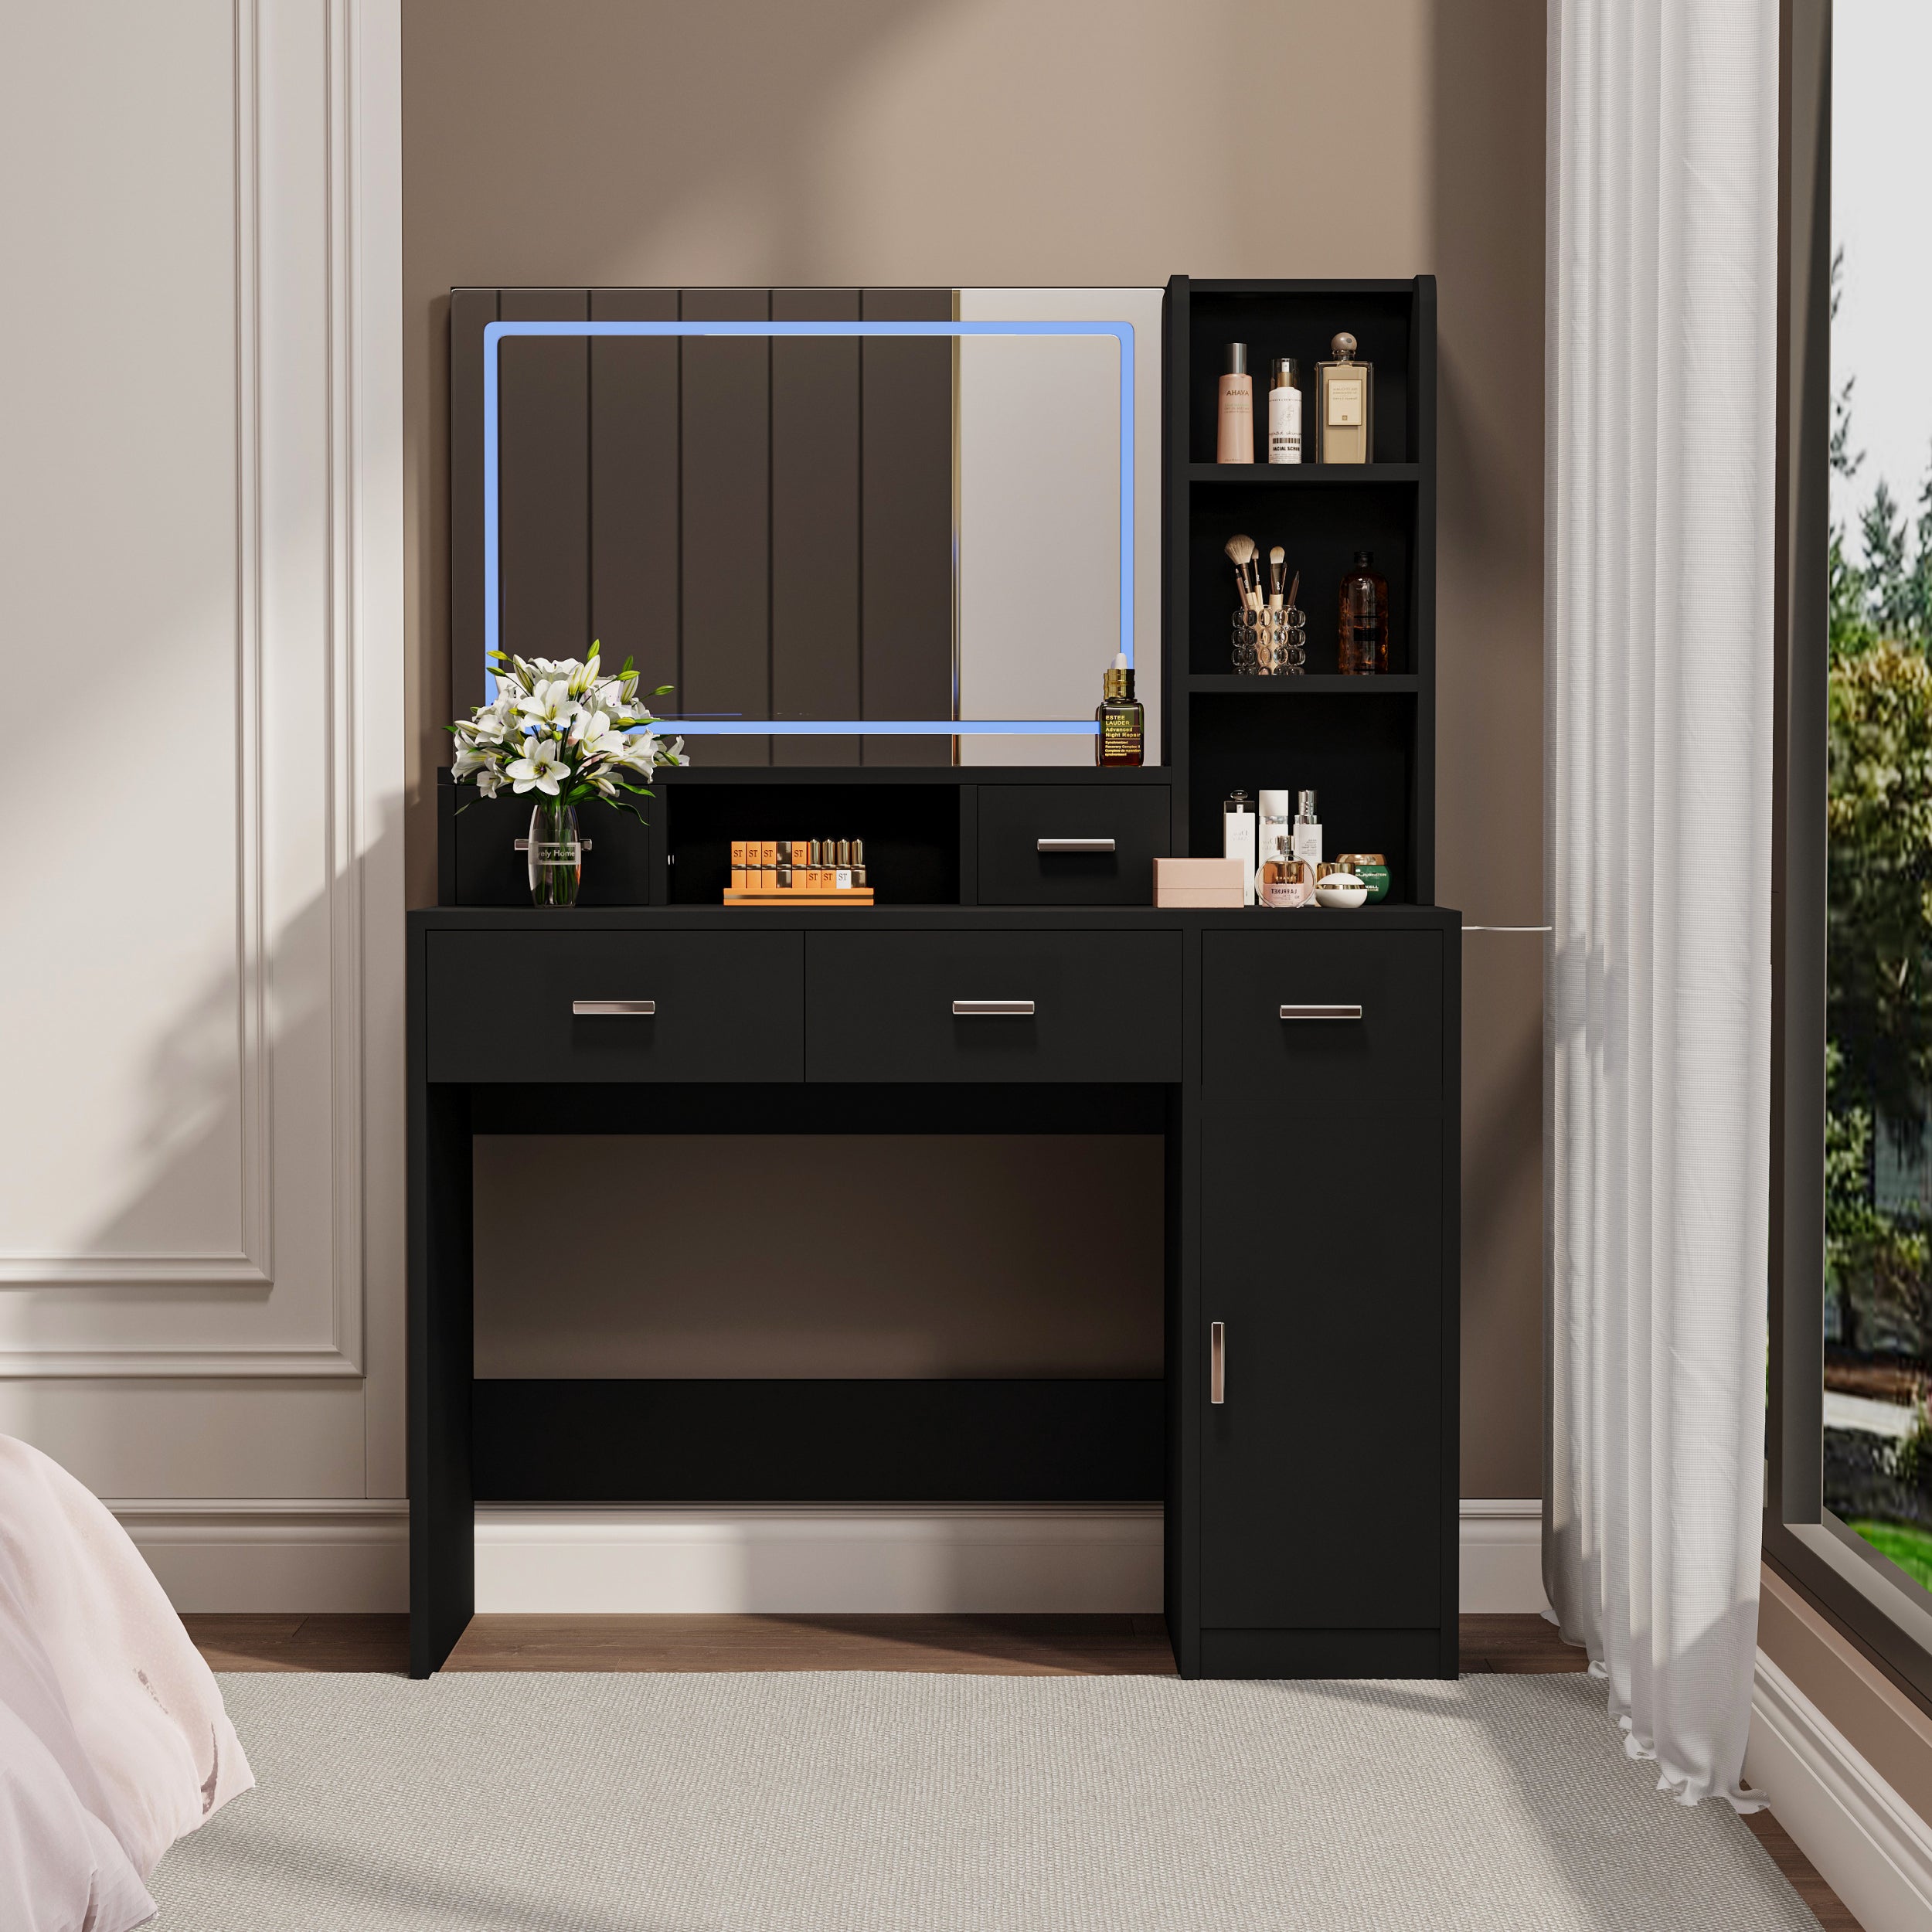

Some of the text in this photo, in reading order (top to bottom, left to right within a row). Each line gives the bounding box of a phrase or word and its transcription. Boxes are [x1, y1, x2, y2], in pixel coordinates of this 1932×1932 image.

[733, 849, 743, 858] ST
[748, 849, 758, 858] ST
[764, 849, 773, 858] ST
[794, 849, 804, 858] ST
[808, 872, 818, 881] ST
[824, 872, 833, 881] ST
[838, 872, 848, 881] ST
